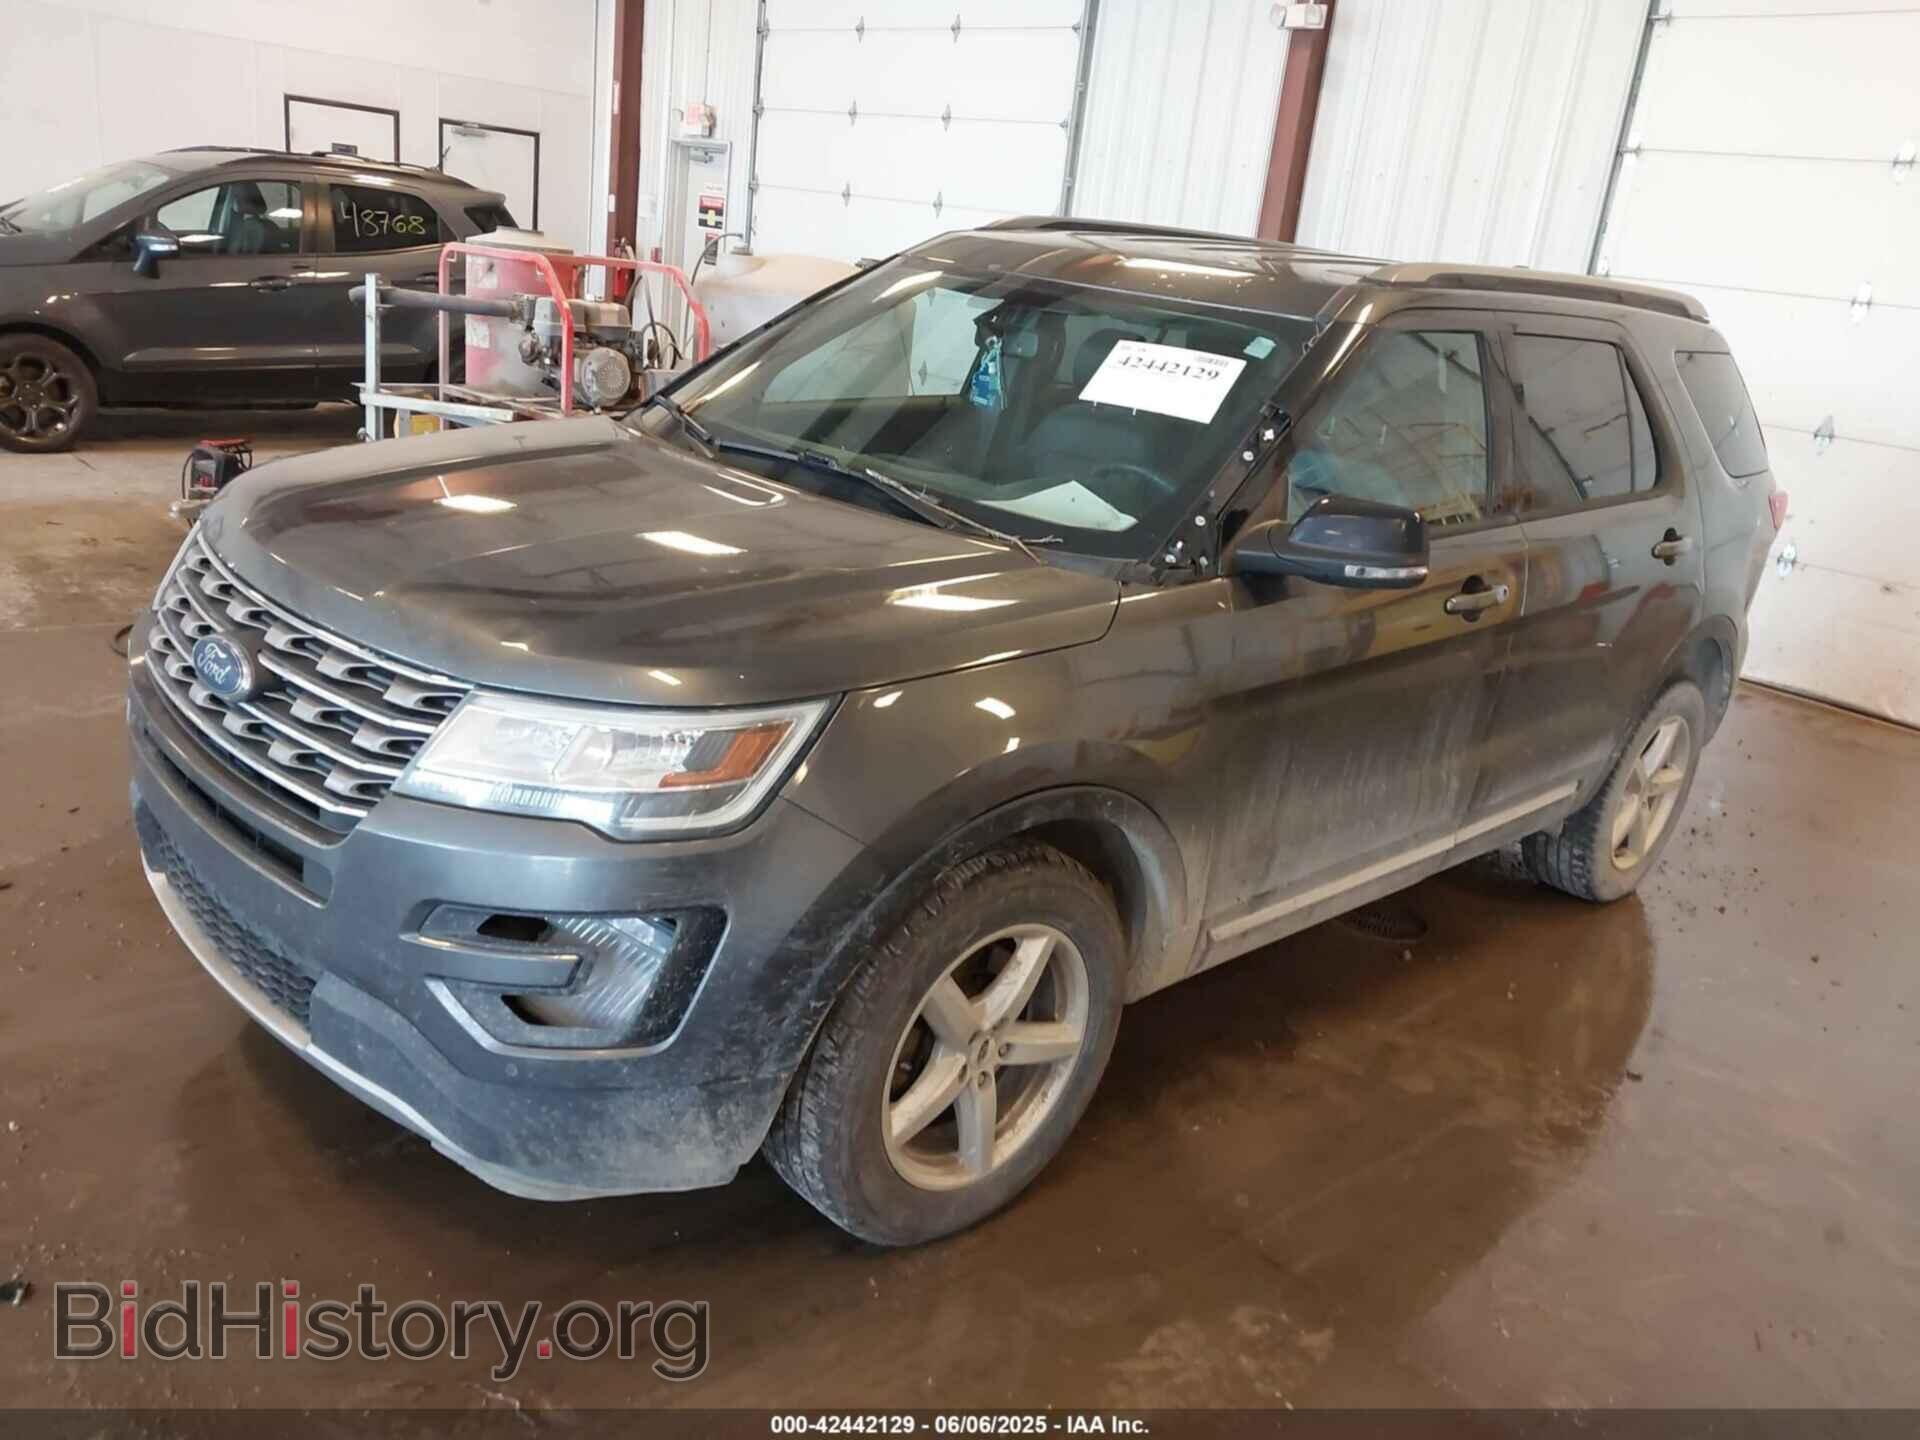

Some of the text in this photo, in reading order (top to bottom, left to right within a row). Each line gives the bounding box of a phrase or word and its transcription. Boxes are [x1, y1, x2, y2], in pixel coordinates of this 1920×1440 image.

[340, 200, 427, 238] 48768
[1117, 355, 1221, 381] 42442129
[196, 642, 232, 685] Ford
